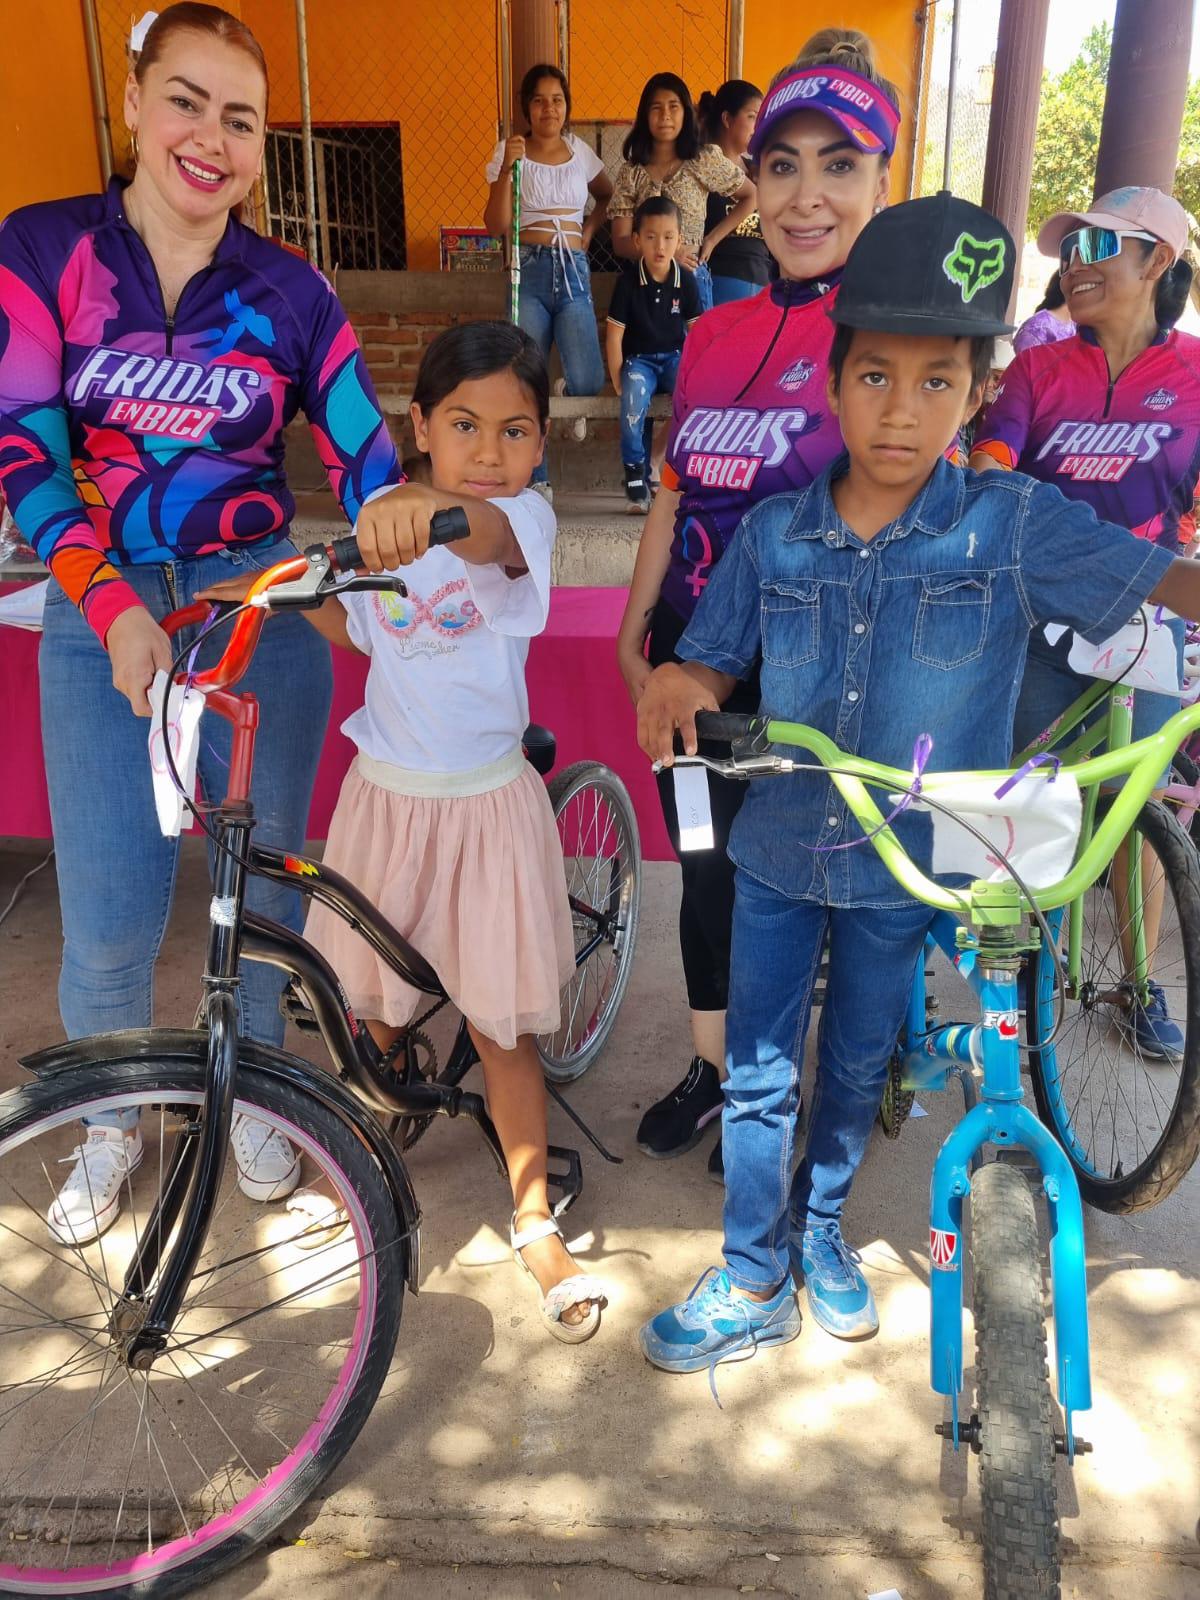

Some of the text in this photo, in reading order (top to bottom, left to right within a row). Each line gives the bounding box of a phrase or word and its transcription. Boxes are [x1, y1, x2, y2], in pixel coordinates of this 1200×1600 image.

[764, 76, 874, 119] FRIDAS EN BICI
[73, 348, 260, 420] FRIDAS
[111, 401, 211, 438] EN BICI
[673, 409, 805, 466] FRIDAS
[1036, 422, 1172, 462] FRIDAS
[687, 455, 757, 489] EN BICI
[1060, 455, 1132, 480] EN BICI
